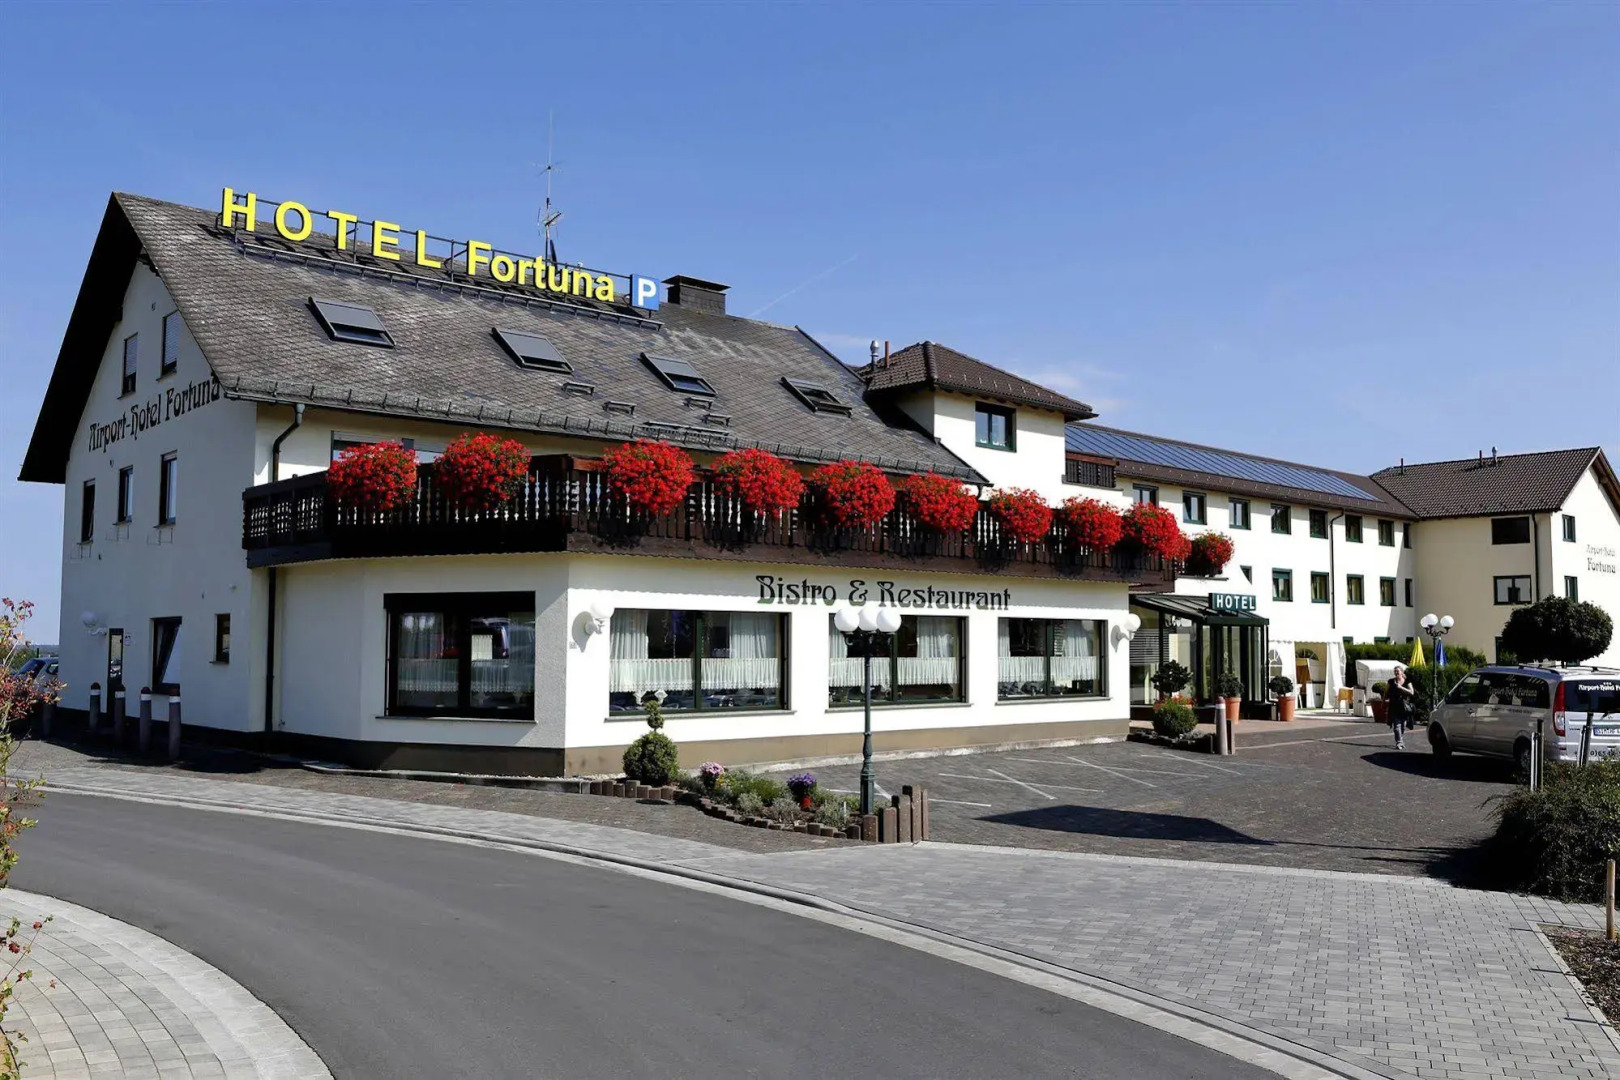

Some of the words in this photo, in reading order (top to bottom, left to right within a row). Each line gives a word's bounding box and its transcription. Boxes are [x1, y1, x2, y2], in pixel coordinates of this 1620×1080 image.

[221, 187, 442, 269] HOTEL
[466, 240, 615, 302] Fortuna
[636, 278, 657, 306] P
[165, 377, 220, 422] Fortuna
[1587, 557, 1616, 574] Fortuna
[755, 575, 837, 606] Bistro
[849, 580, 869, 606] &
[876, 581, 1011, 610] Restaurant
[1216, 594, 1255, 610] HOTEL
